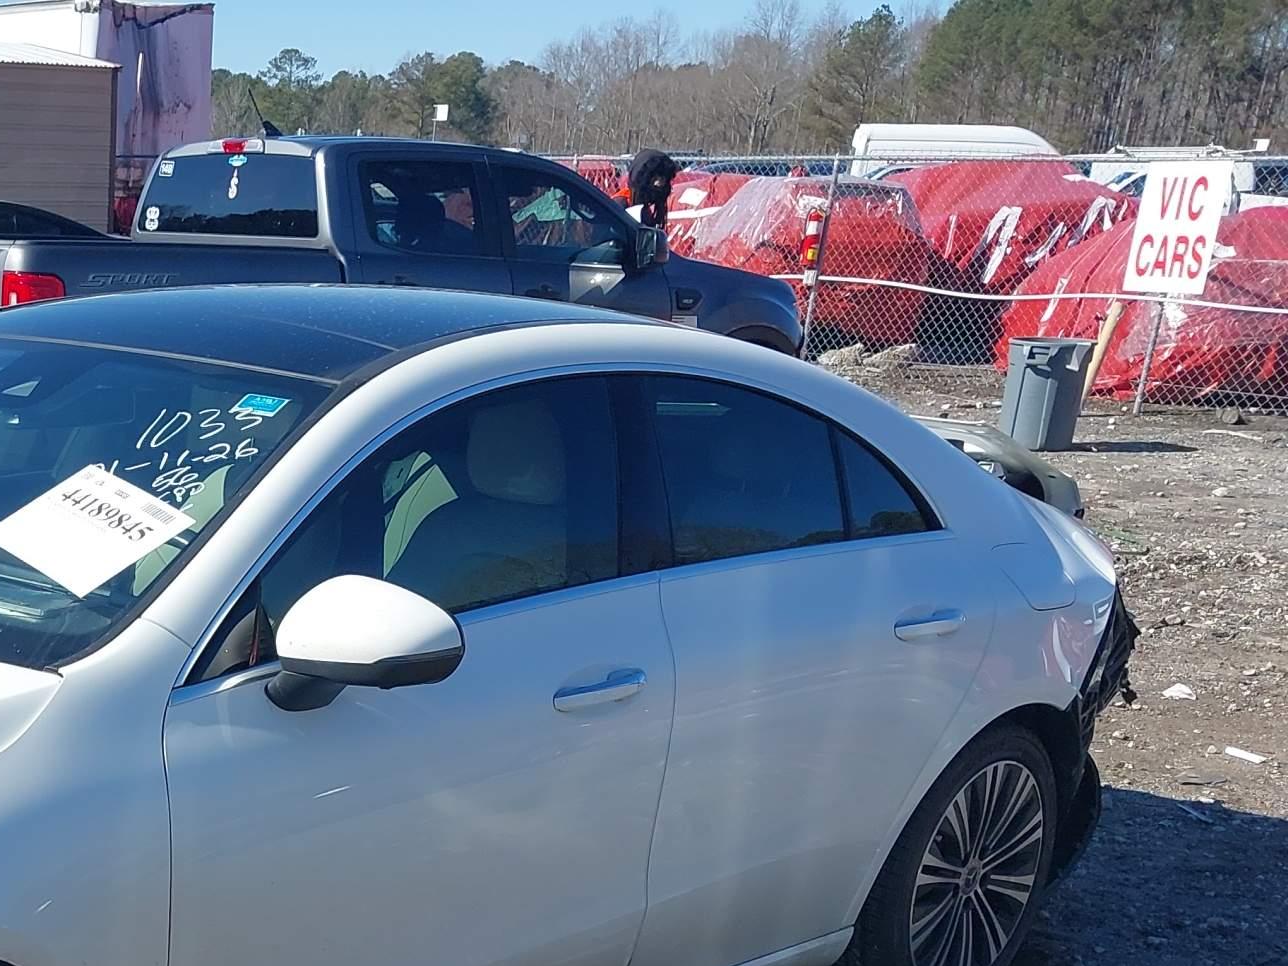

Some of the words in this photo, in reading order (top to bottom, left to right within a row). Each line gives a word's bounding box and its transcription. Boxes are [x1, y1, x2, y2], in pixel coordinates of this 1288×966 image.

[1161, 176, 1209, 221] VIC
[1136, 235, 1207, 279] CARS
[79, 272, 180, 288] SPORT
[62, 490, 154, 541] 44189845
